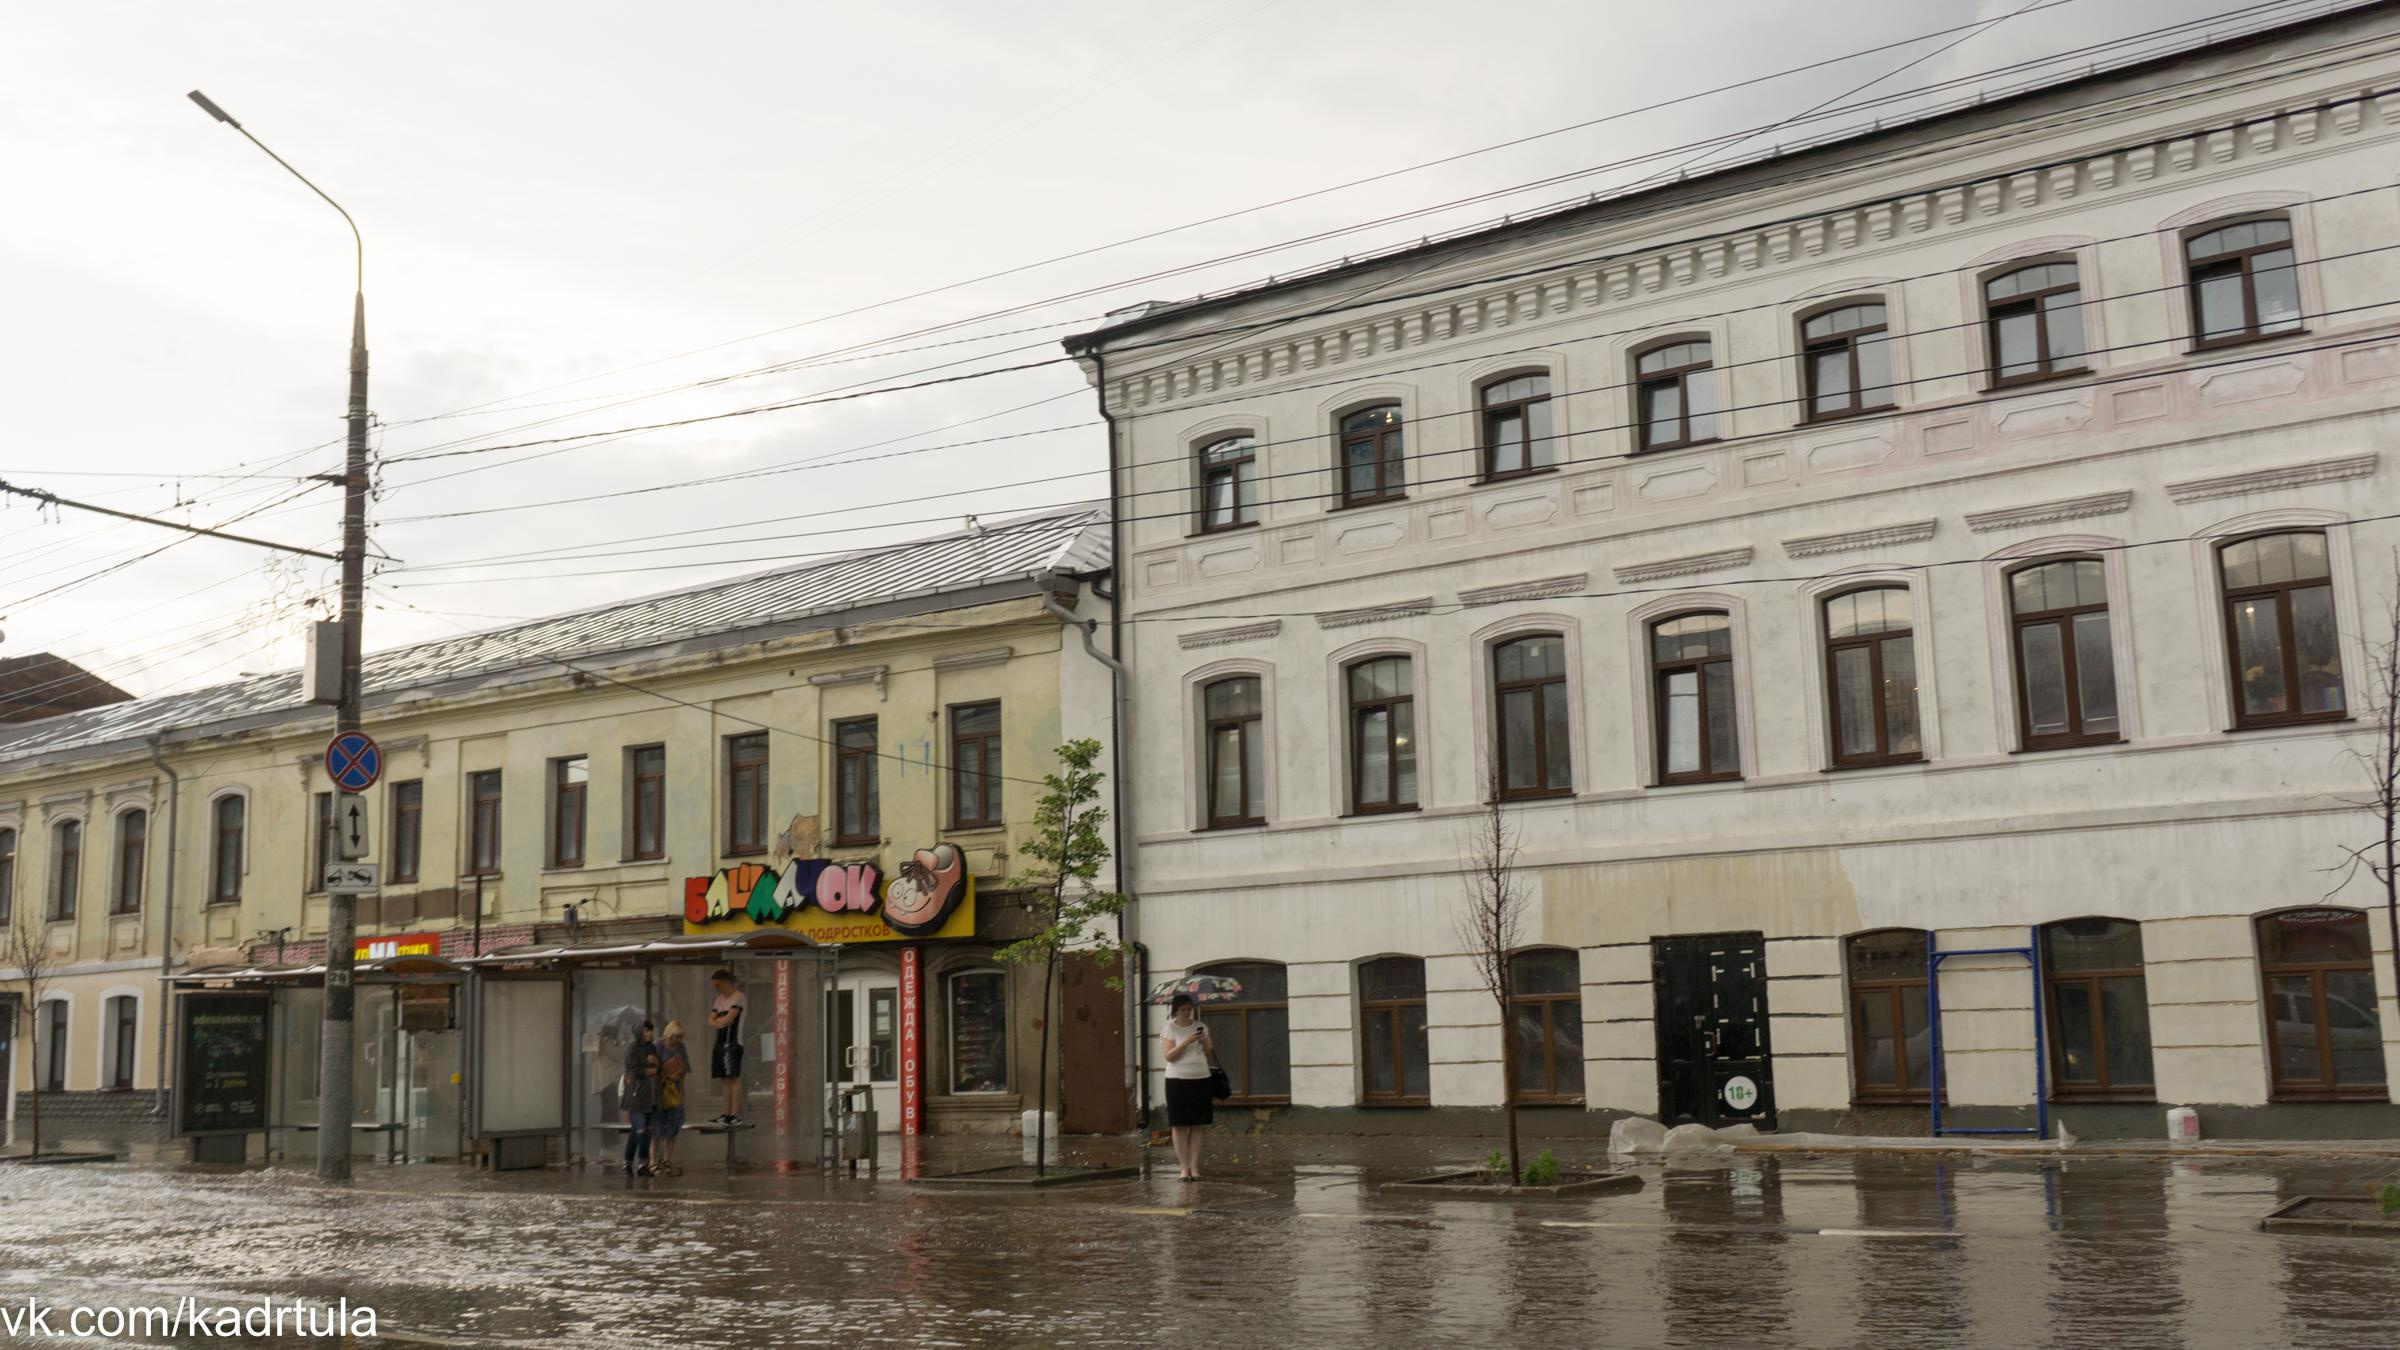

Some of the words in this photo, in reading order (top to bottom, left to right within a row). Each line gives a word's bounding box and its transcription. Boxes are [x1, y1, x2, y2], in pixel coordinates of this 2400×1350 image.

[683, 857, 882, 925] БАШМАЧОК
[807, 925, 890, 941] ПОДРОСТКОВ
[903, 950, 917, 1041] ОДЕЖДА
[775, 1062, 788, 1137] ОБУВЬ
[903, 1058, 917, 1136] ОБУВЬ
